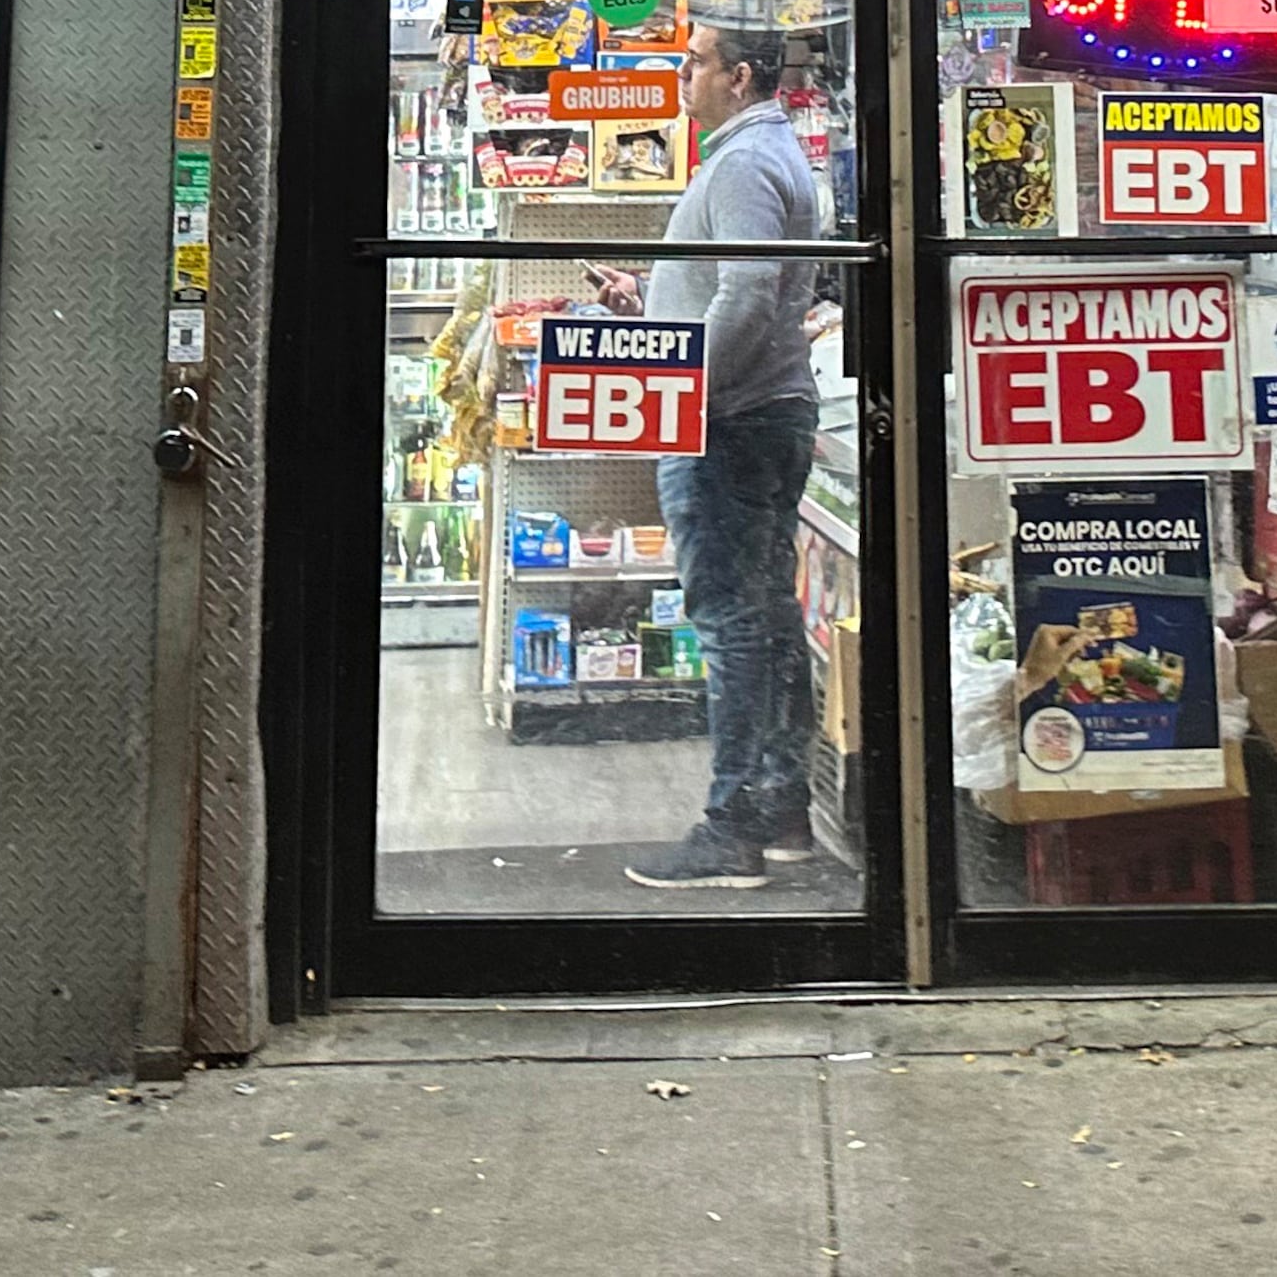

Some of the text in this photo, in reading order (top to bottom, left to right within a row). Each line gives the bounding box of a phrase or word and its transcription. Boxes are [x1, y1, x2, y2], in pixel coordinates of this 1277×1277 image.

[561, 84, 666, 110] GRUBHUB
[1106, 102, 1261, 133] ACEPTAMOS
[1110, 148, 1256, 216] EBT
[971, 286, 1227, 344] ACEPTAMOS
[554, 325, 693, 361] WE ACCEPT
[546, 372, 696, 445] EBT
[978, 349, 1226, 446] EBT
[1019, 518, 1202, 542] COMPRA LOCAL
[1052, 551, 1166, 579] OTC AQUÍ
